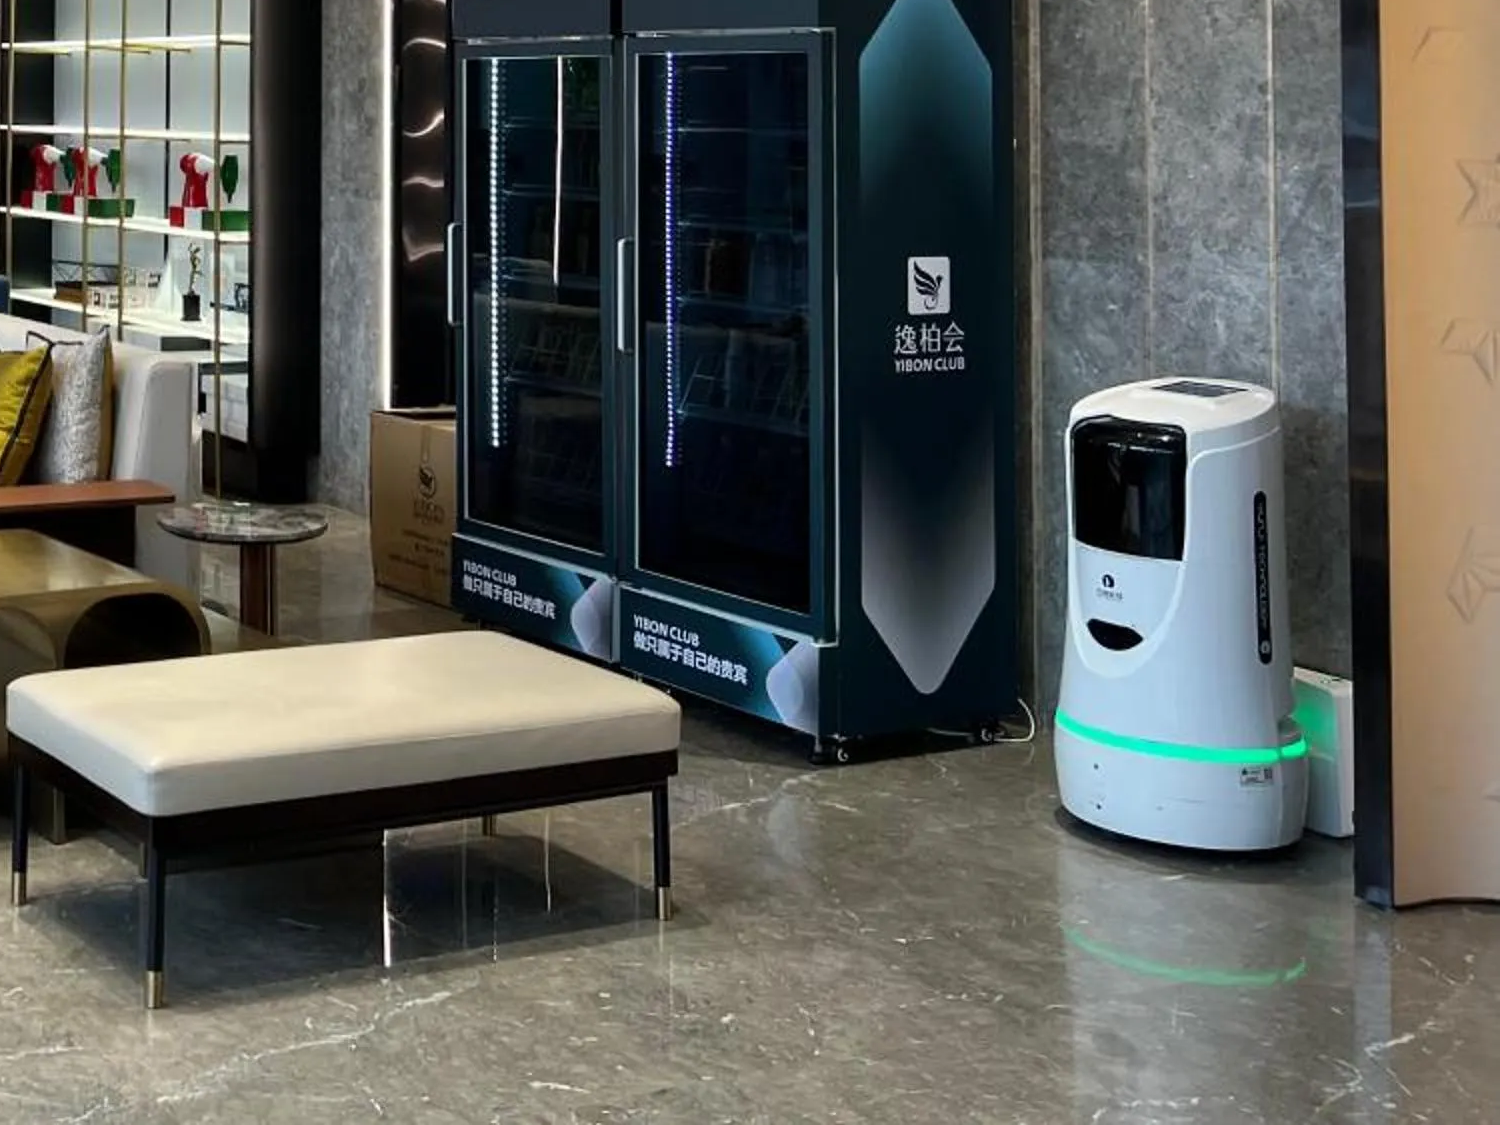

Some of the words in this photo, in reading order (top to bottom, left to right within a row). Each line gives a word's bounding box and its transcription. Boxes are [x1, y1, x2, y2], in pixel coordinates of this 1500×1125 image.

[894, 320, 965, 354] 逸柏会
[894, 357, 933, 373] YIBON
[934, 356, 965, 371] CLUB
[492, 569, 517, 587] CLUB
[633, 614, 668, 637] YIBON
[669, 625, 700, 648] CLUB
[633, 631, 749, 685] 做只属于自己的贵宾
